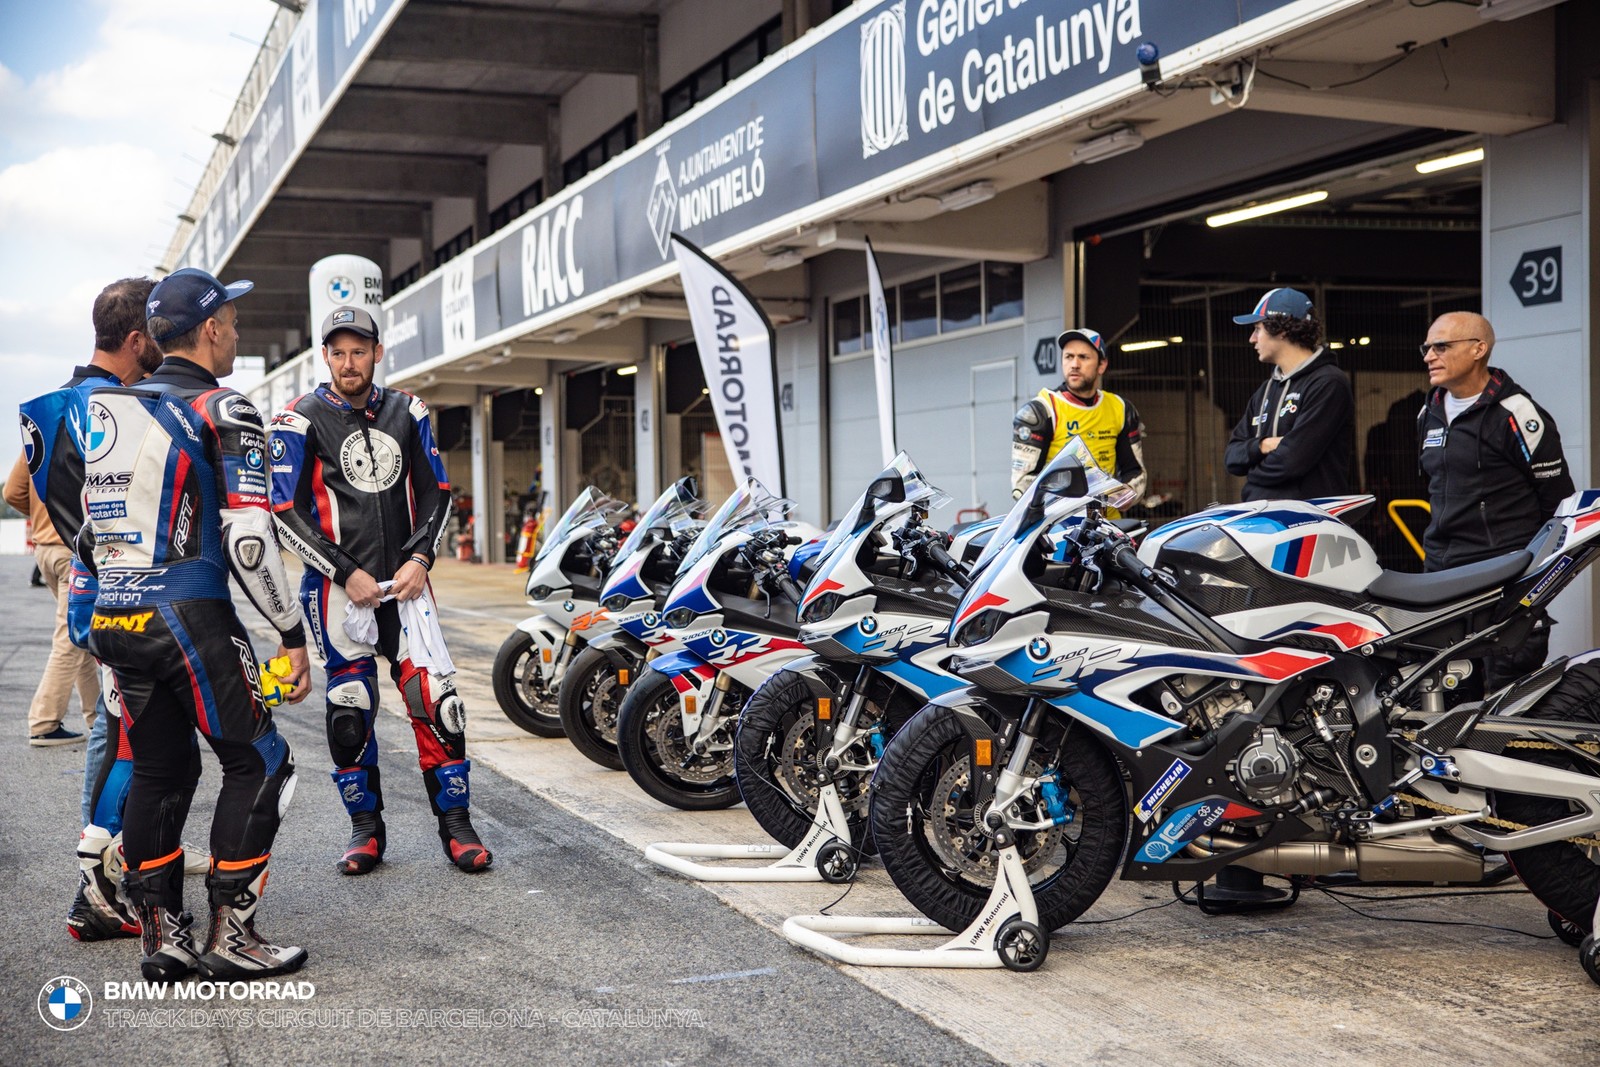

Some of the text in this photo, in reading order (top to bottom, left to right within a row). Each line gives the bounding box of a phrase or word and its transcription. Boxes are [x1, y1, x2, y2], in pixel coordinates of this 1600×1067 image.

[918, 0, 1142, 133] de Catalunya
[678, 115, 765, 183] AJUNTAMENT DE
[679, 148, 765, 231] MONTMELÓ
[521, 194, 584, 317] RACC
[1521, 255, 1559, 299] 39
[1037, 343, 1057, 371] 40
[86, 471, 134, 488] MAS
[342, 451, 357, 483] DEVOTO
[96, 487, 128, 495] TEAM
[173, 492, 193, 558] RST
[278, 526, 331, 575] BMW Motorrad
[260, 565, 286, 614] TECMAS
[1537, 561, 1566, 593] MICHELIN
[1146, 762, 1184, 808] MICHELIN
[1203, 805, 1225, 828] GILLES
[969, 925, 986, 946] BMW
[984, 892, 1010, 927] Motorrad
